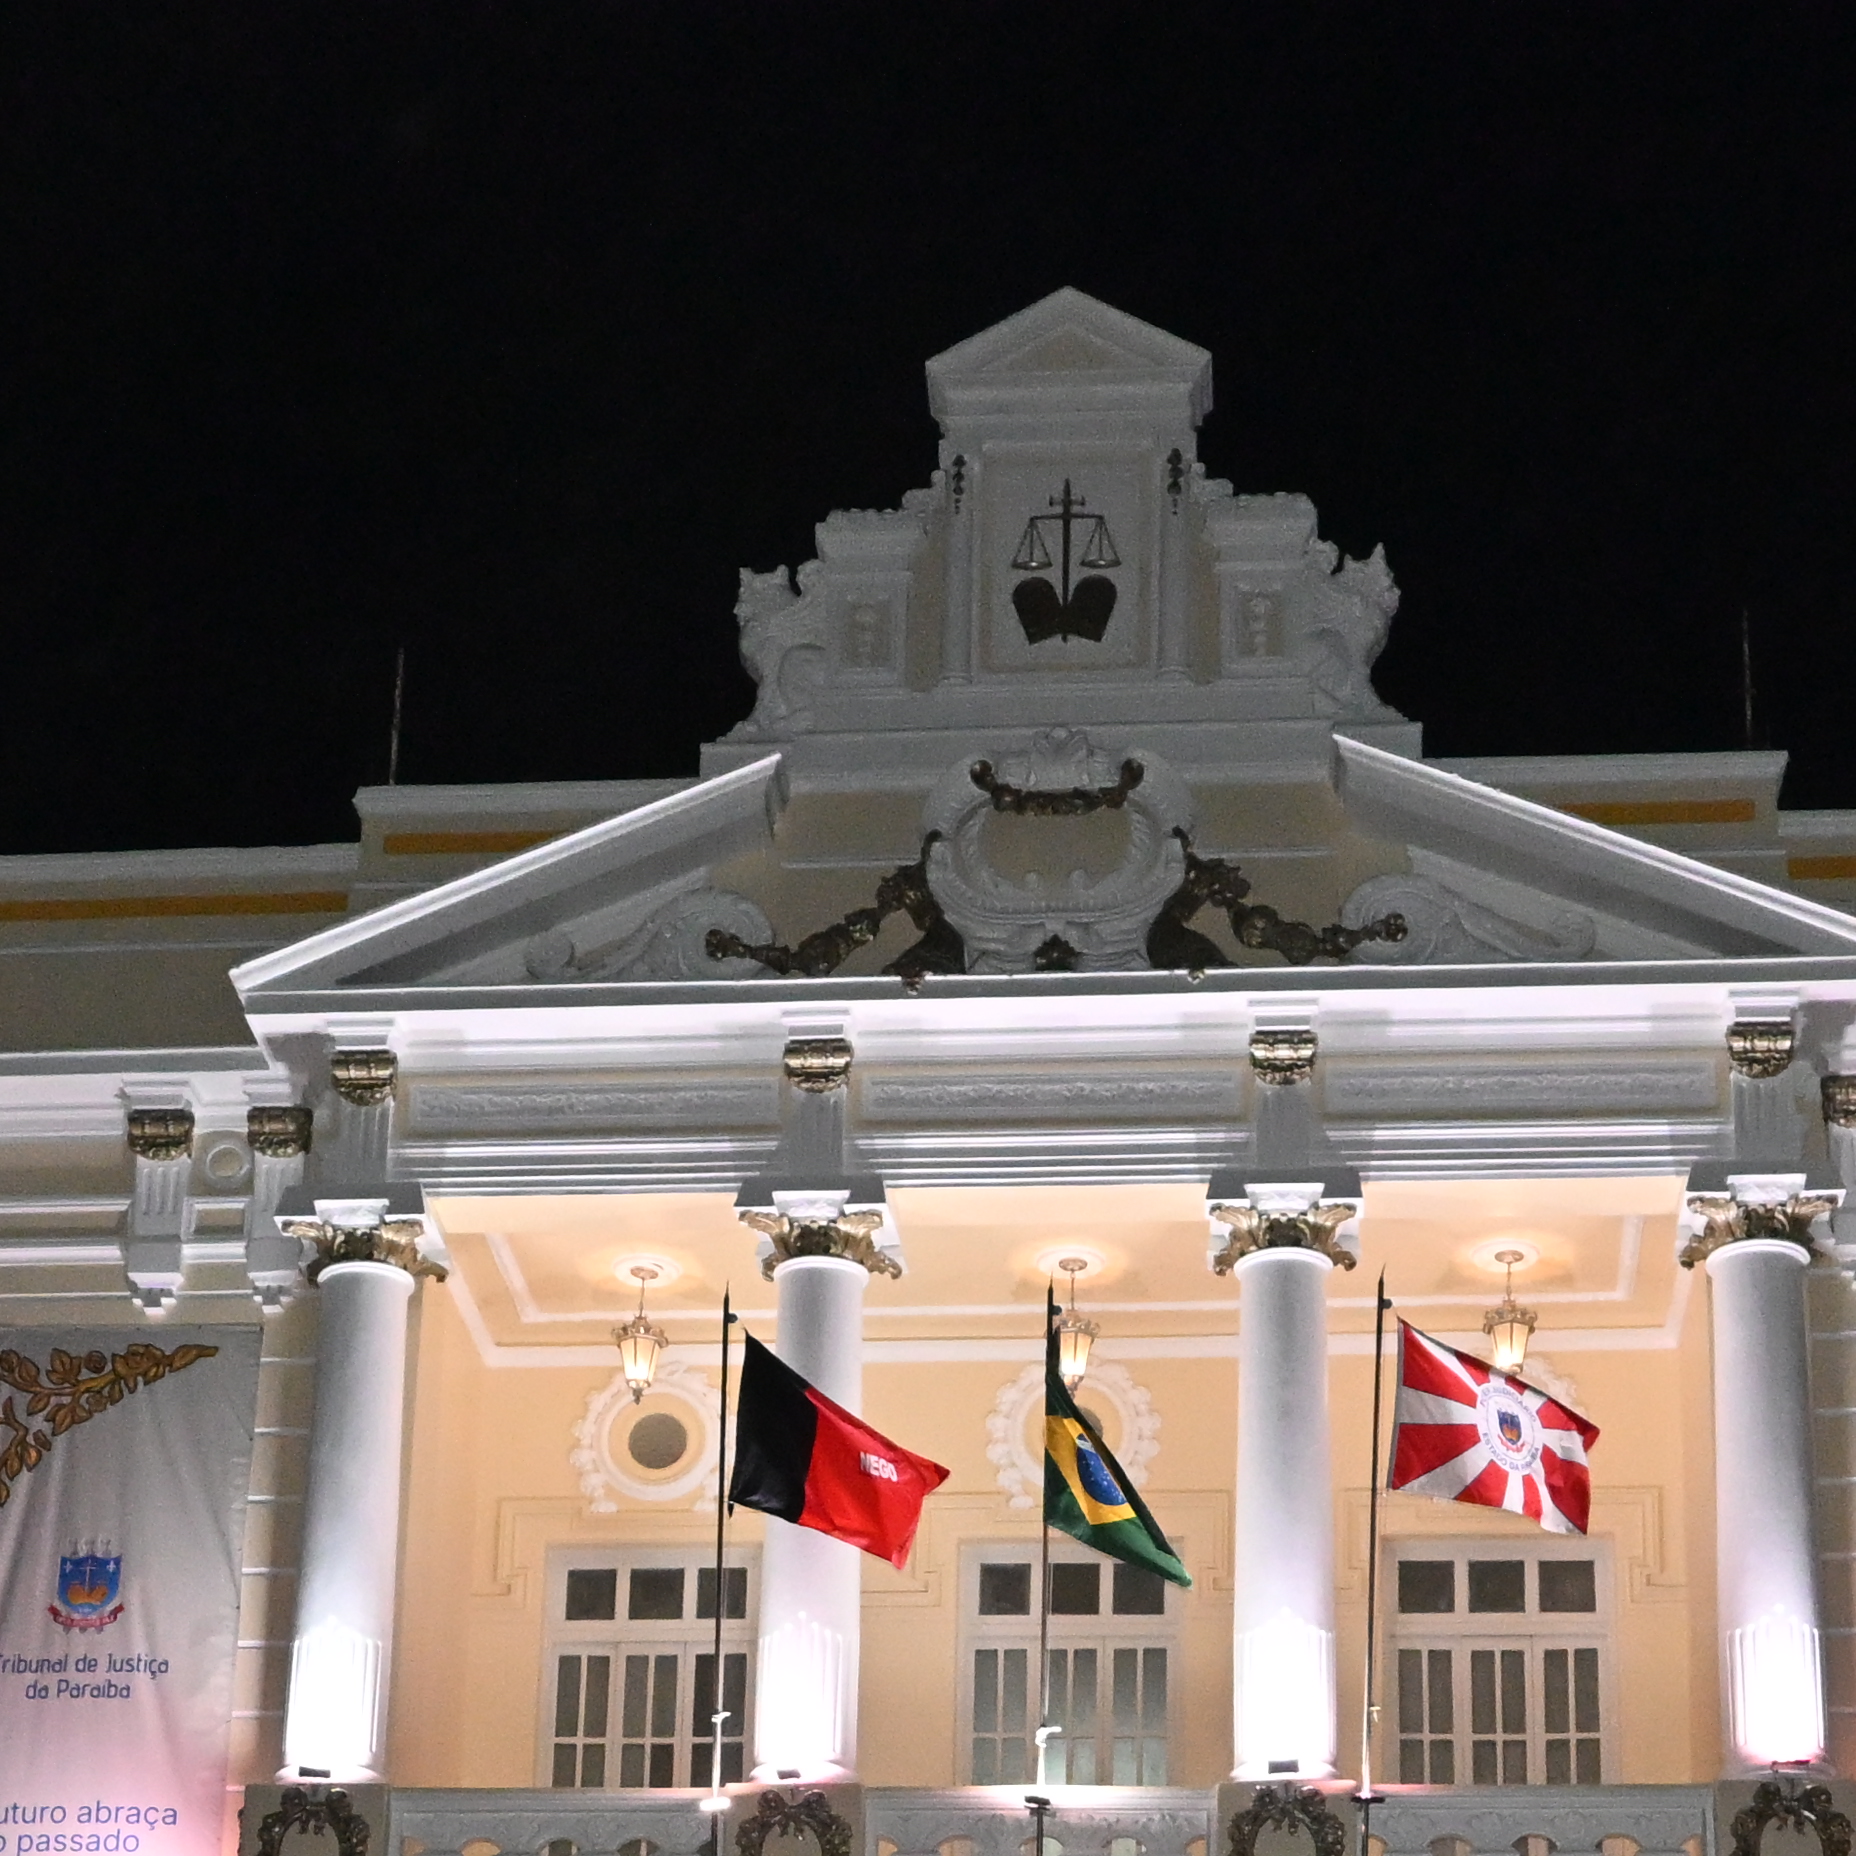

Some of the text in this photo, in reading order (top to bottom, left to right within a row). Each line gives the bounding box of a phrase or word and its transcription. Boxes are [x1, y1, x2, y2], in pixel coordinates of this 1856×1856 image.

[860, 1451, 898, 1483] NEGO
[75, 1653, 98, 1673] de
[105, 1653, 170, 1680] Justiça
[25, 1680, 49, 1700] da
[77, 1800, 178, 1831] abraça
